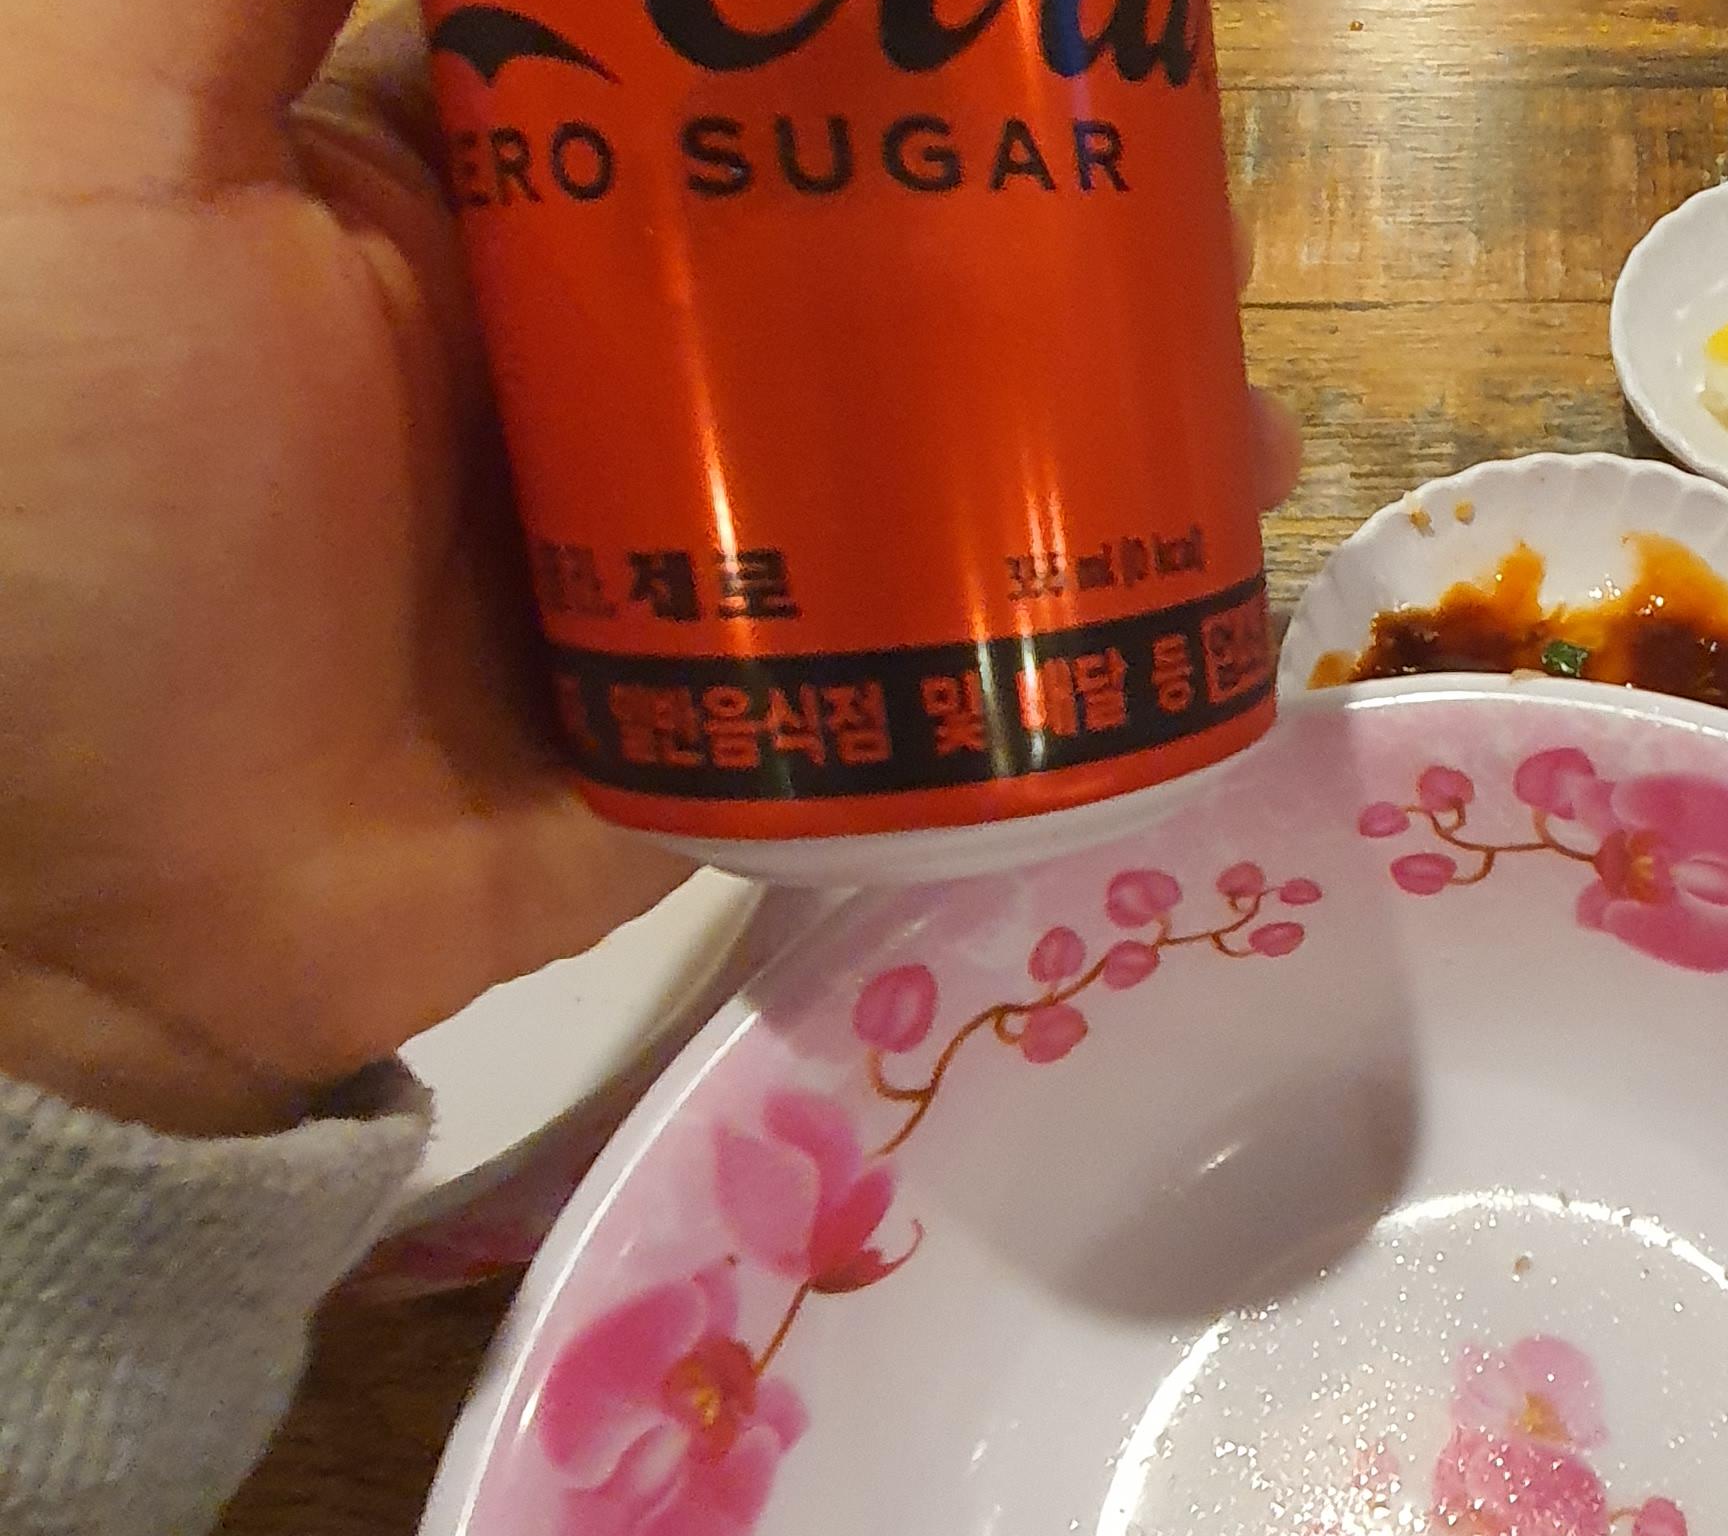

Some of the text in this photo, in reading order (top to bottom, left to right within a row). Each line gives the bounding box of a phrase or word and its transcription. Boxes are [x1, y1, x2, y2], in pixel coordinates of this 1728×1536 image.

[452, 117, 1130, 206] ERO SUGAR
[608, 680, 892, 769] 일반음식점
